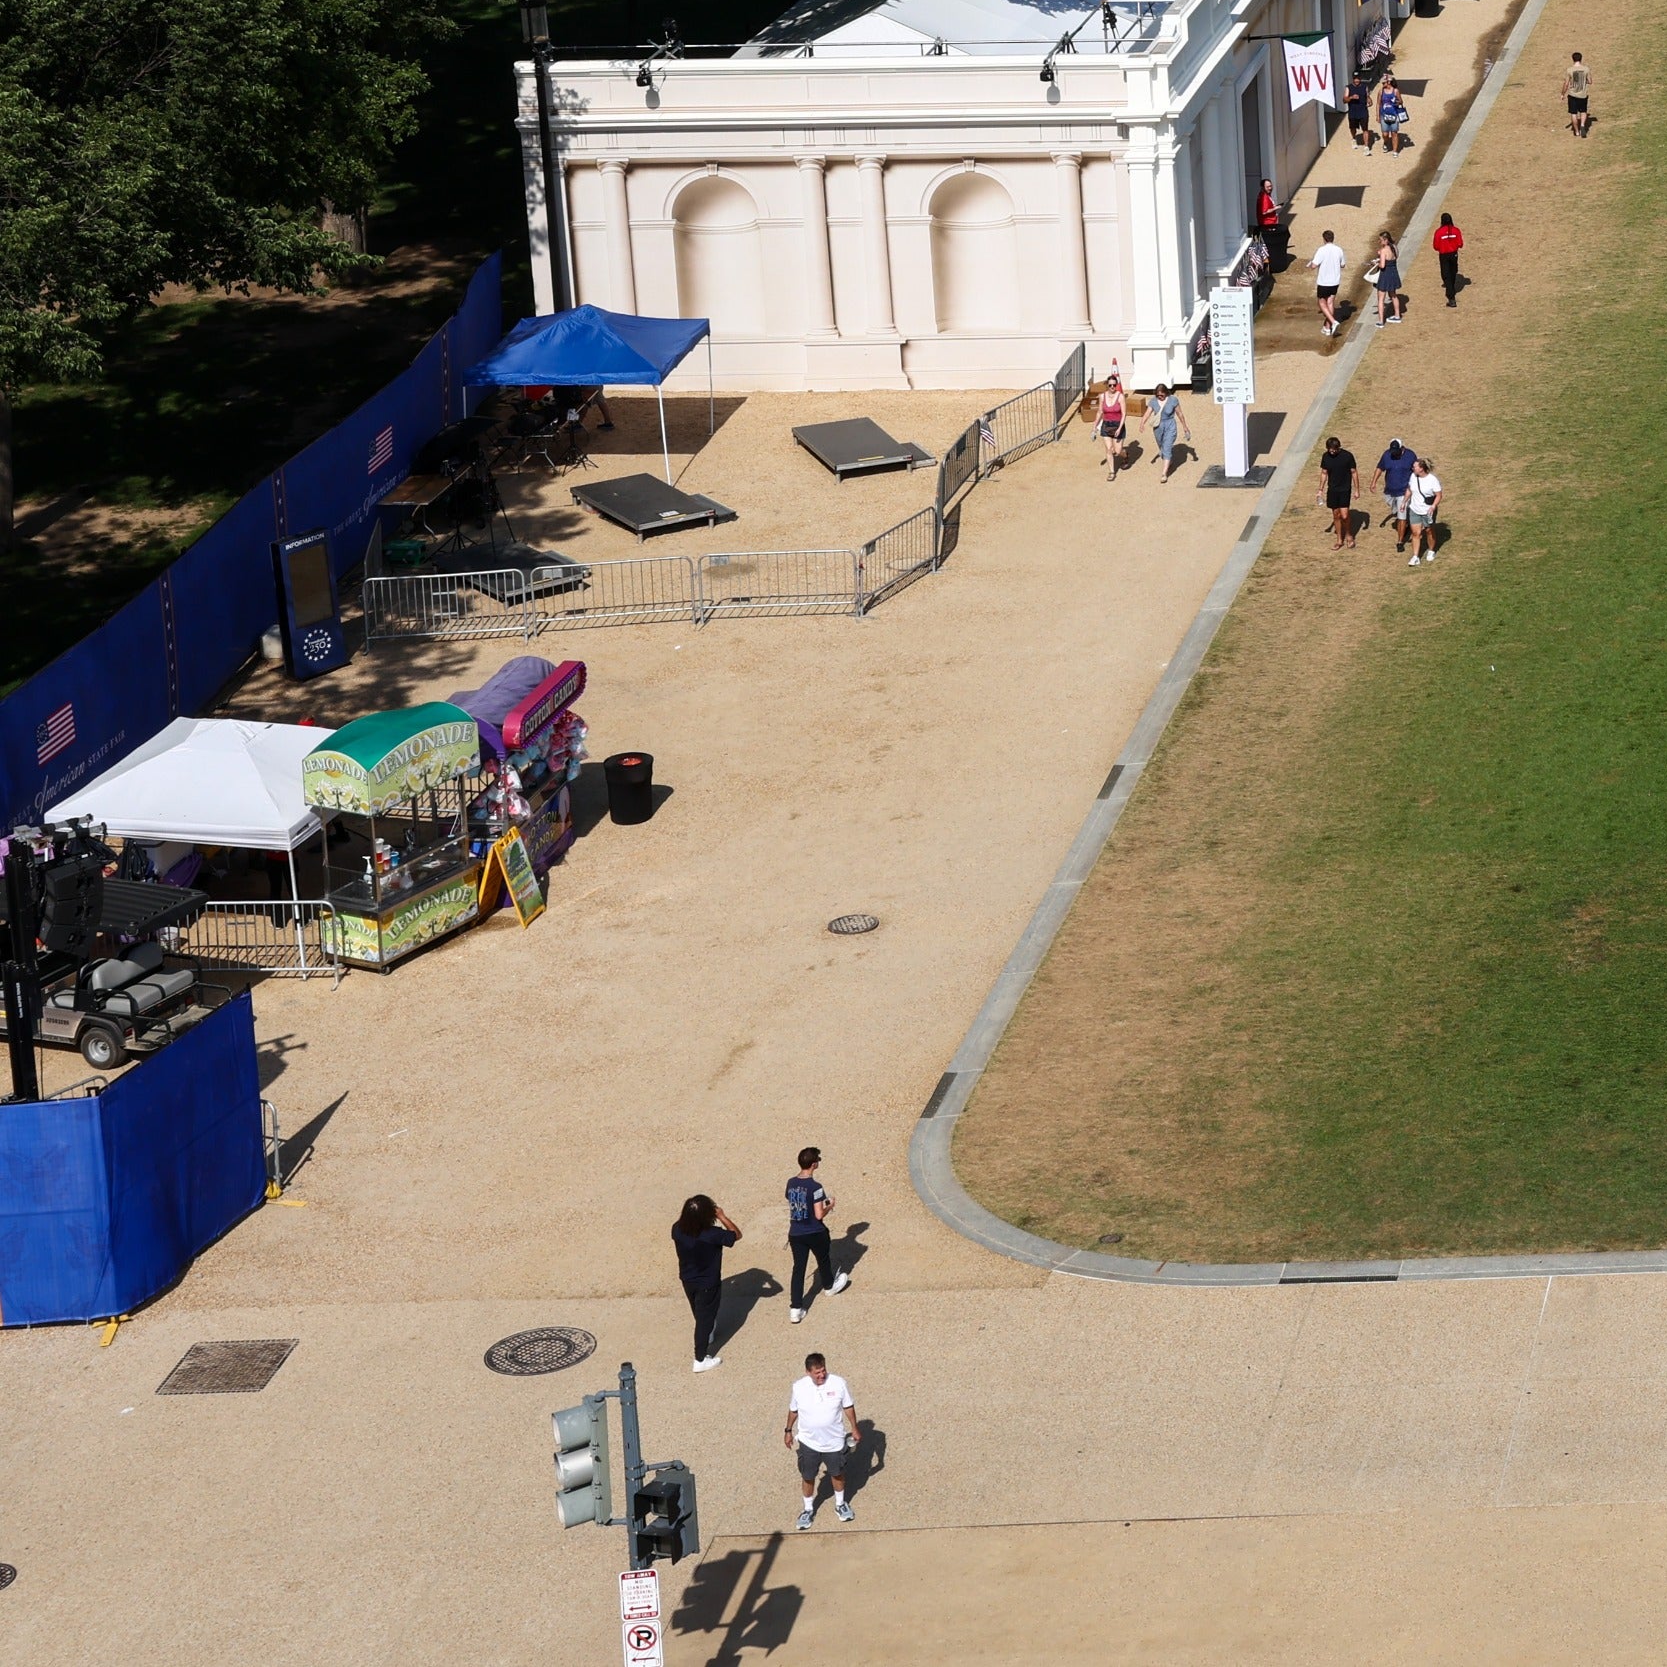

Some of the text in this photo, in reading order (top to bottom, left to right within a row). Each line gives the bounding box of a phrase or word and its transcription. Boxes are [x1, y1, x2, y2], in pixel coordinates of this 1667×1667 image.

[1290, 64, 1328, 92] WV
[285, 532, 325, 550] INFORMATION
[310, 640, 326, 654] 250
[525, 674, 576, 737] COTTON CANDY
[88, 744, 109, 767] STATE
[110, 730, 126, 749] FAIR
[373, 723, 474, 786] LEMONADE
[303, 757, 368, 782] LEMONADE
[387, 887, 472, 940] LEMONADE
